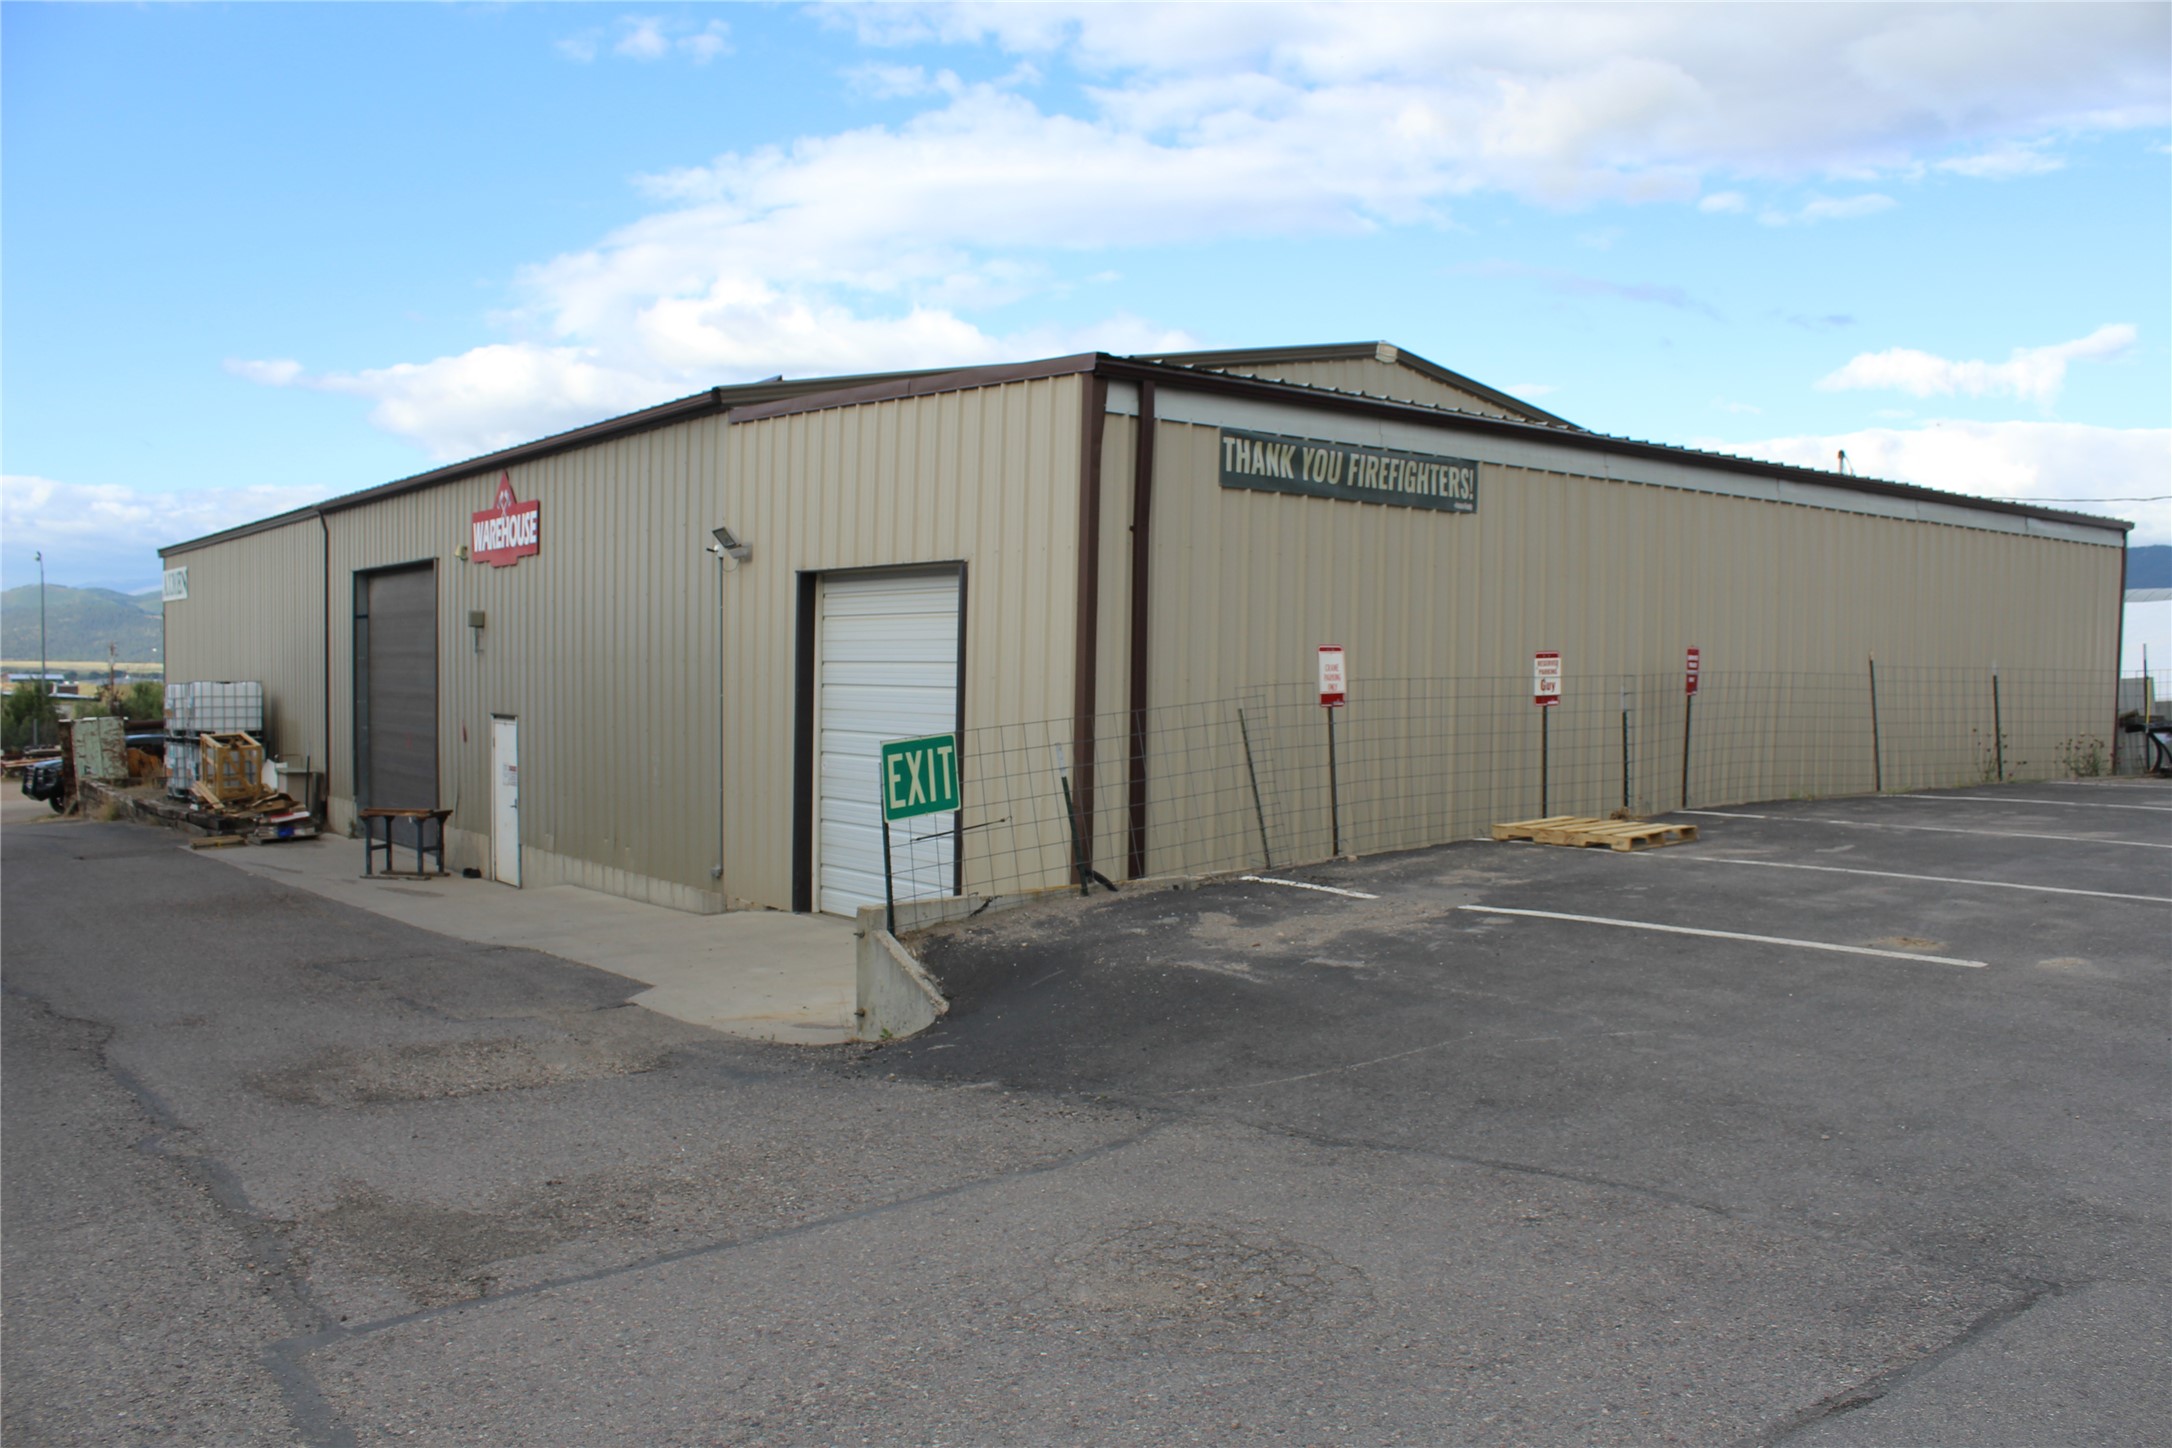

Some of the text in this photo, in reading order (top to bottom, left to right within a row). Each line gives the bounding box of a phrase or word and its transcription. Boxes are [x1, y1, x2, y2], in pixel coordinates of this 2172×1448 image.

[1223, 437, 1474, 500] THANK YOU FIREFIGHTERS!
[473, 510, 538, 552] WAREHOUSE
[1540, 678, 1556, 693] Guy
[887, 745, 953, 809] EXIT
